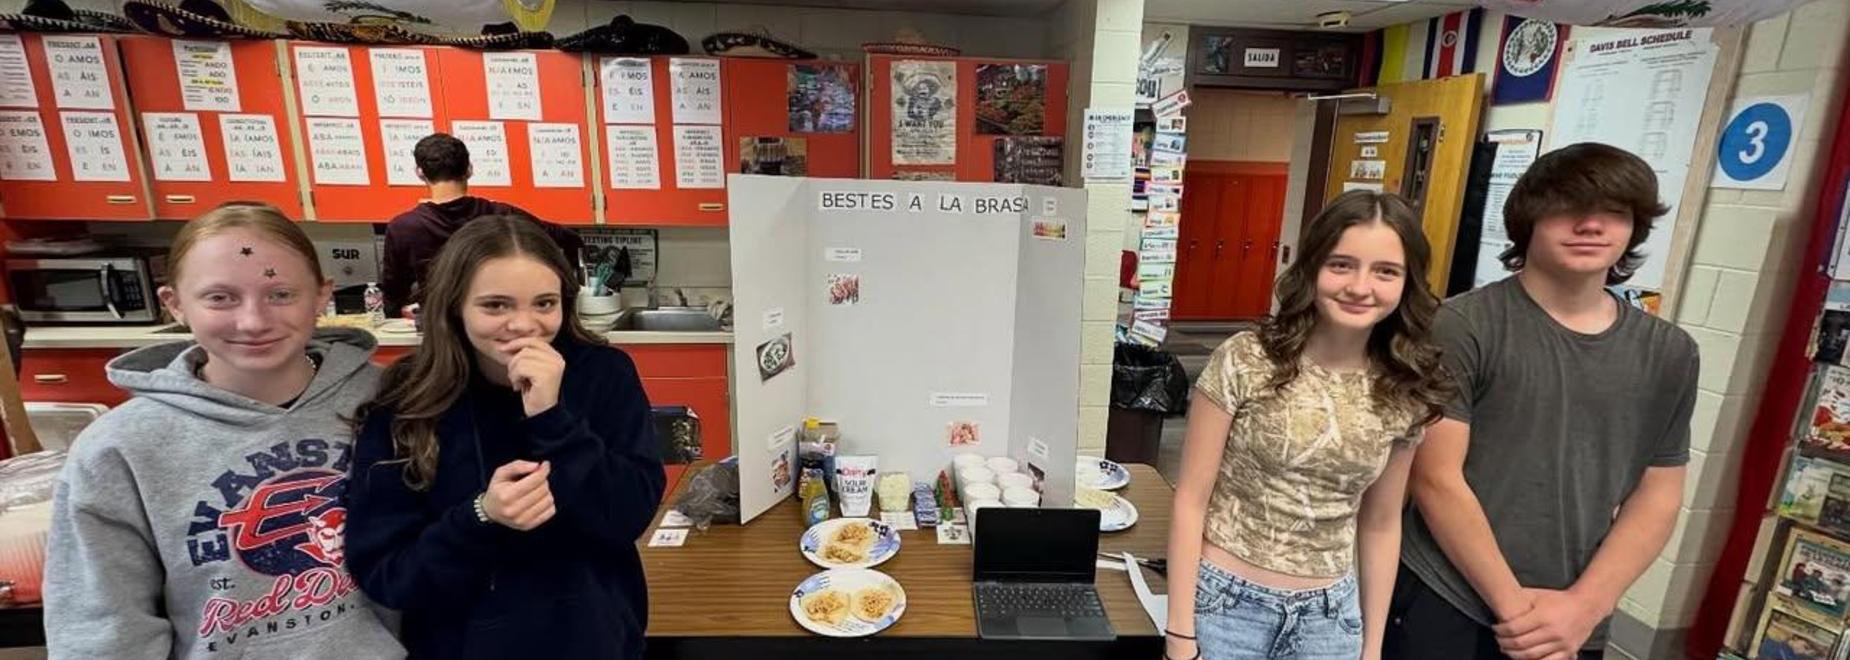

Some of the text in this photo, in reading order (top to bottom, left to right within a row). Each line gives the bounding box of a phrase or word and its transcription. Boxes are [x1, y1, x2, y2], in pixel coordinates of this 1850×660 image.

[1590, 30, 1692, 52] DAVIS BELL SCHEDULE
[69, 55, 99, 64] AMOS
[1248, 53, 1275, 62] SALIDA
[689, 72, 716, 80] AMOS
[905, 120, 926, 128] WANT
[928, 120, 944, 128] YOU
[1738, 121, 1769, 164] 3
[822, 193, 894, 210] BESTES
[910, 196, 922, 210] A
[940, 196, 962, 212] LA
[976, 197, 1028, 214] BRASA
[332, 248, 360, 260] SUR
[187, 438, 352, 566] EVANST
[210, 577, 236, 590] est.
[200, 573, 293, 638] Red
